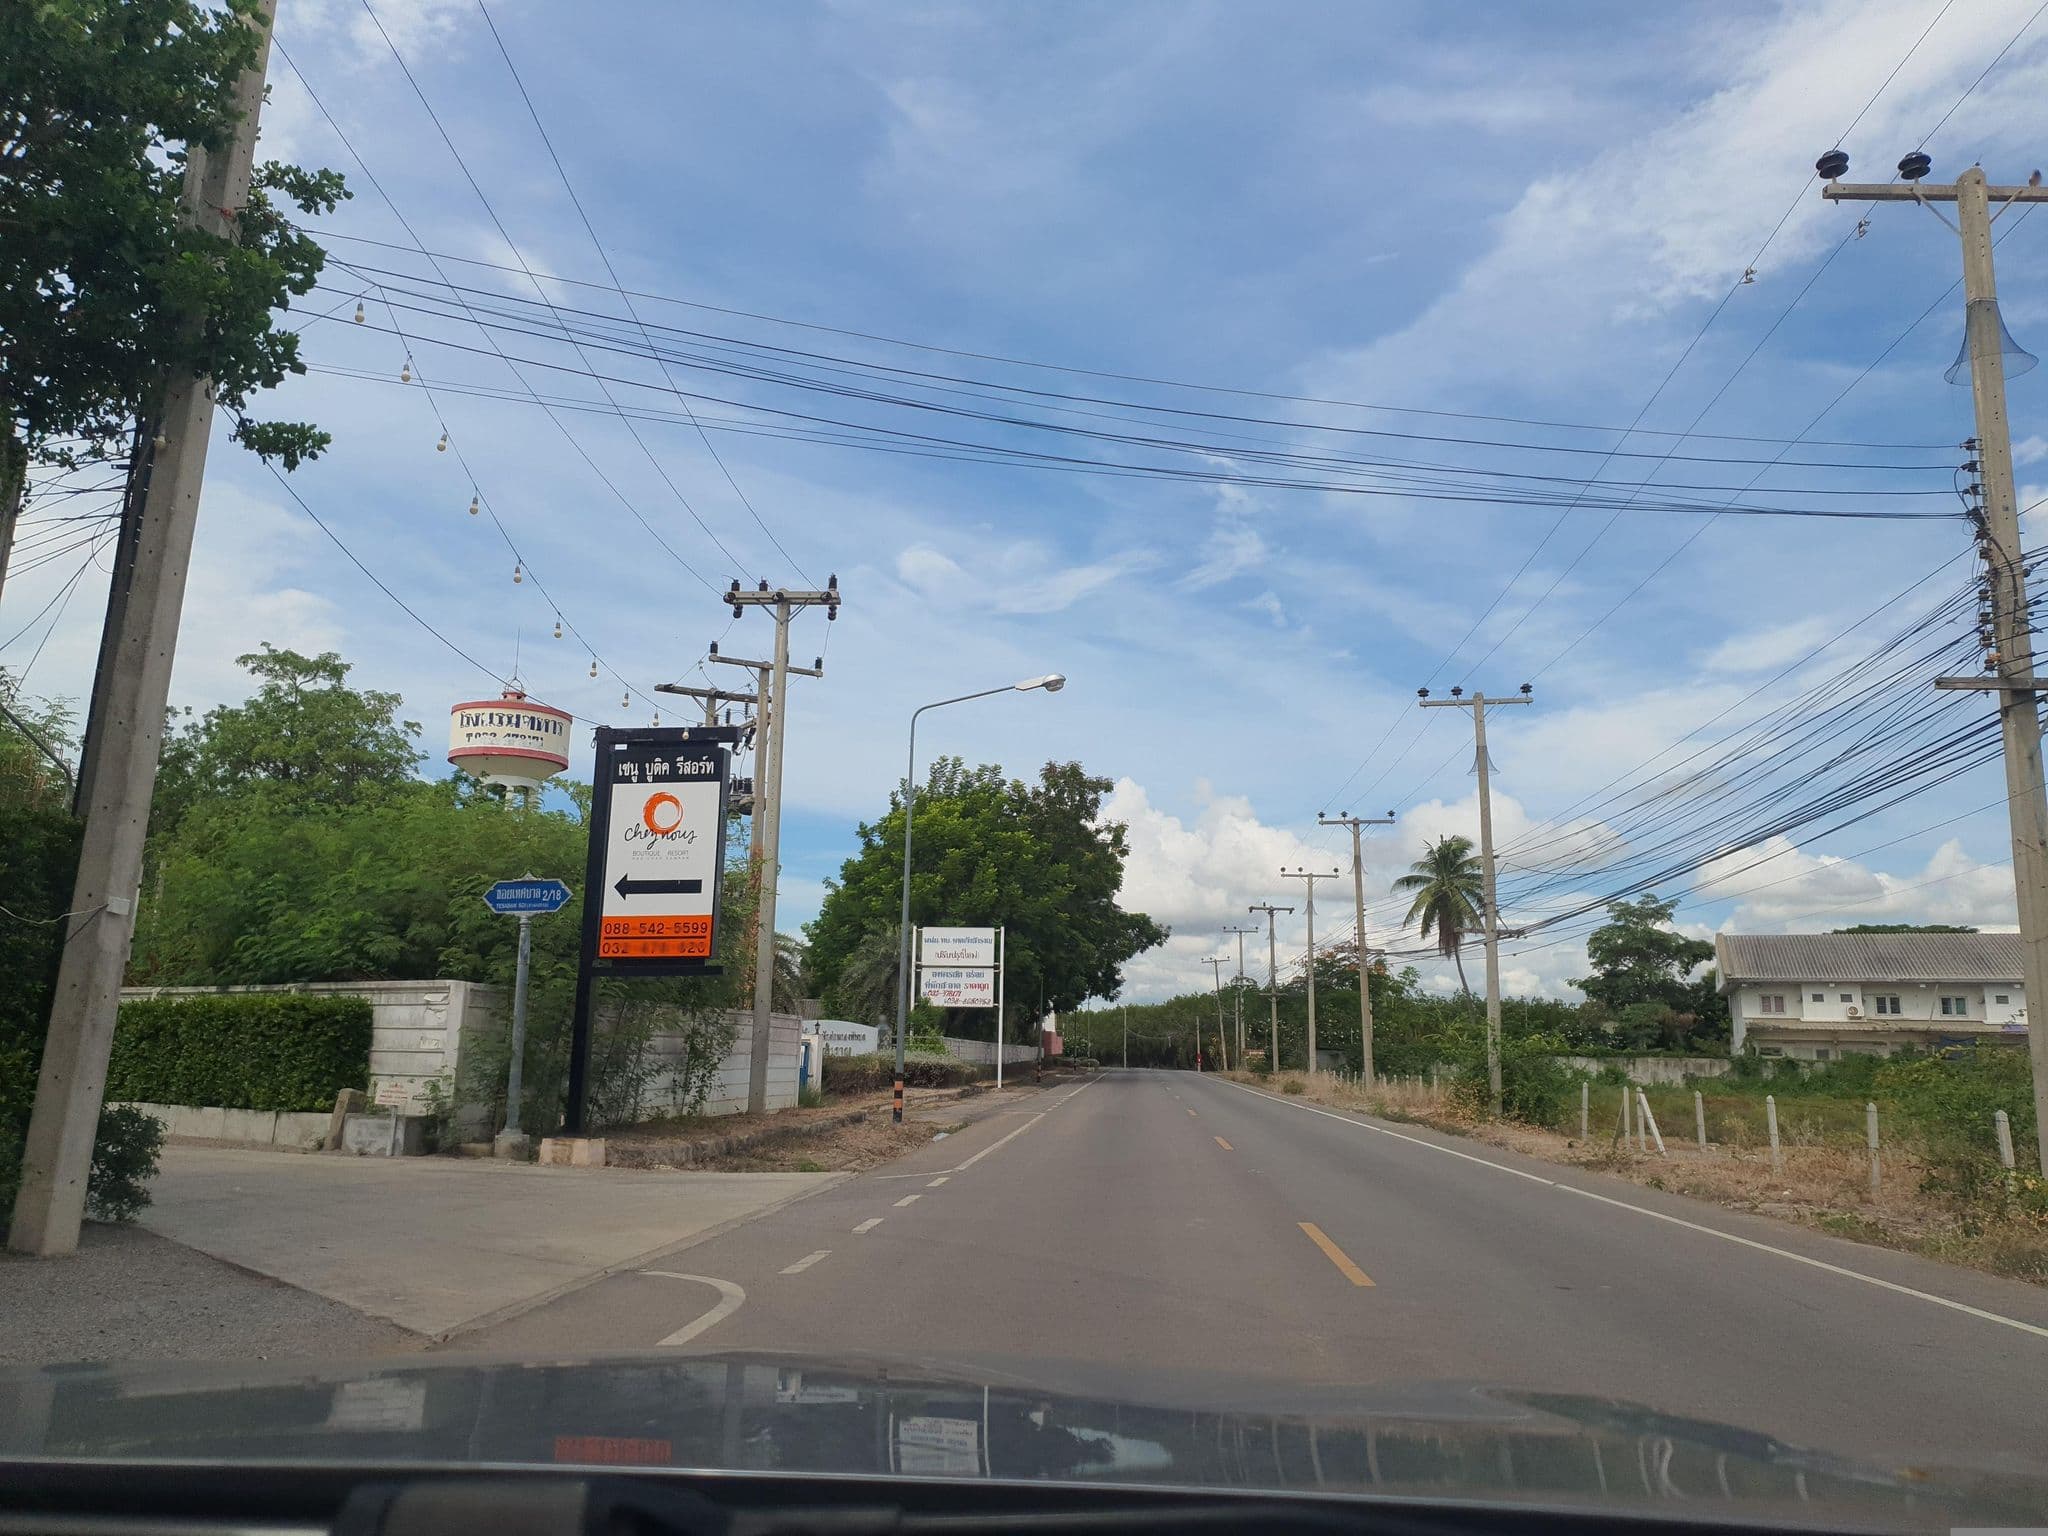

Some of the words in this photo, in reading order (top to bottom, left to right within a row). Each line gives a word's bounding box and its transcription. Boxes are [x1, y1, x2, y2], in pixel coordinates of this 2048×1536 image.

[618, 761, 639, 783] เชนู
[645, 757, 670, 783] บูติค
[676, 755, 715, 775] รีสอร์ท
[542, 889, 562, 901] 2/18
